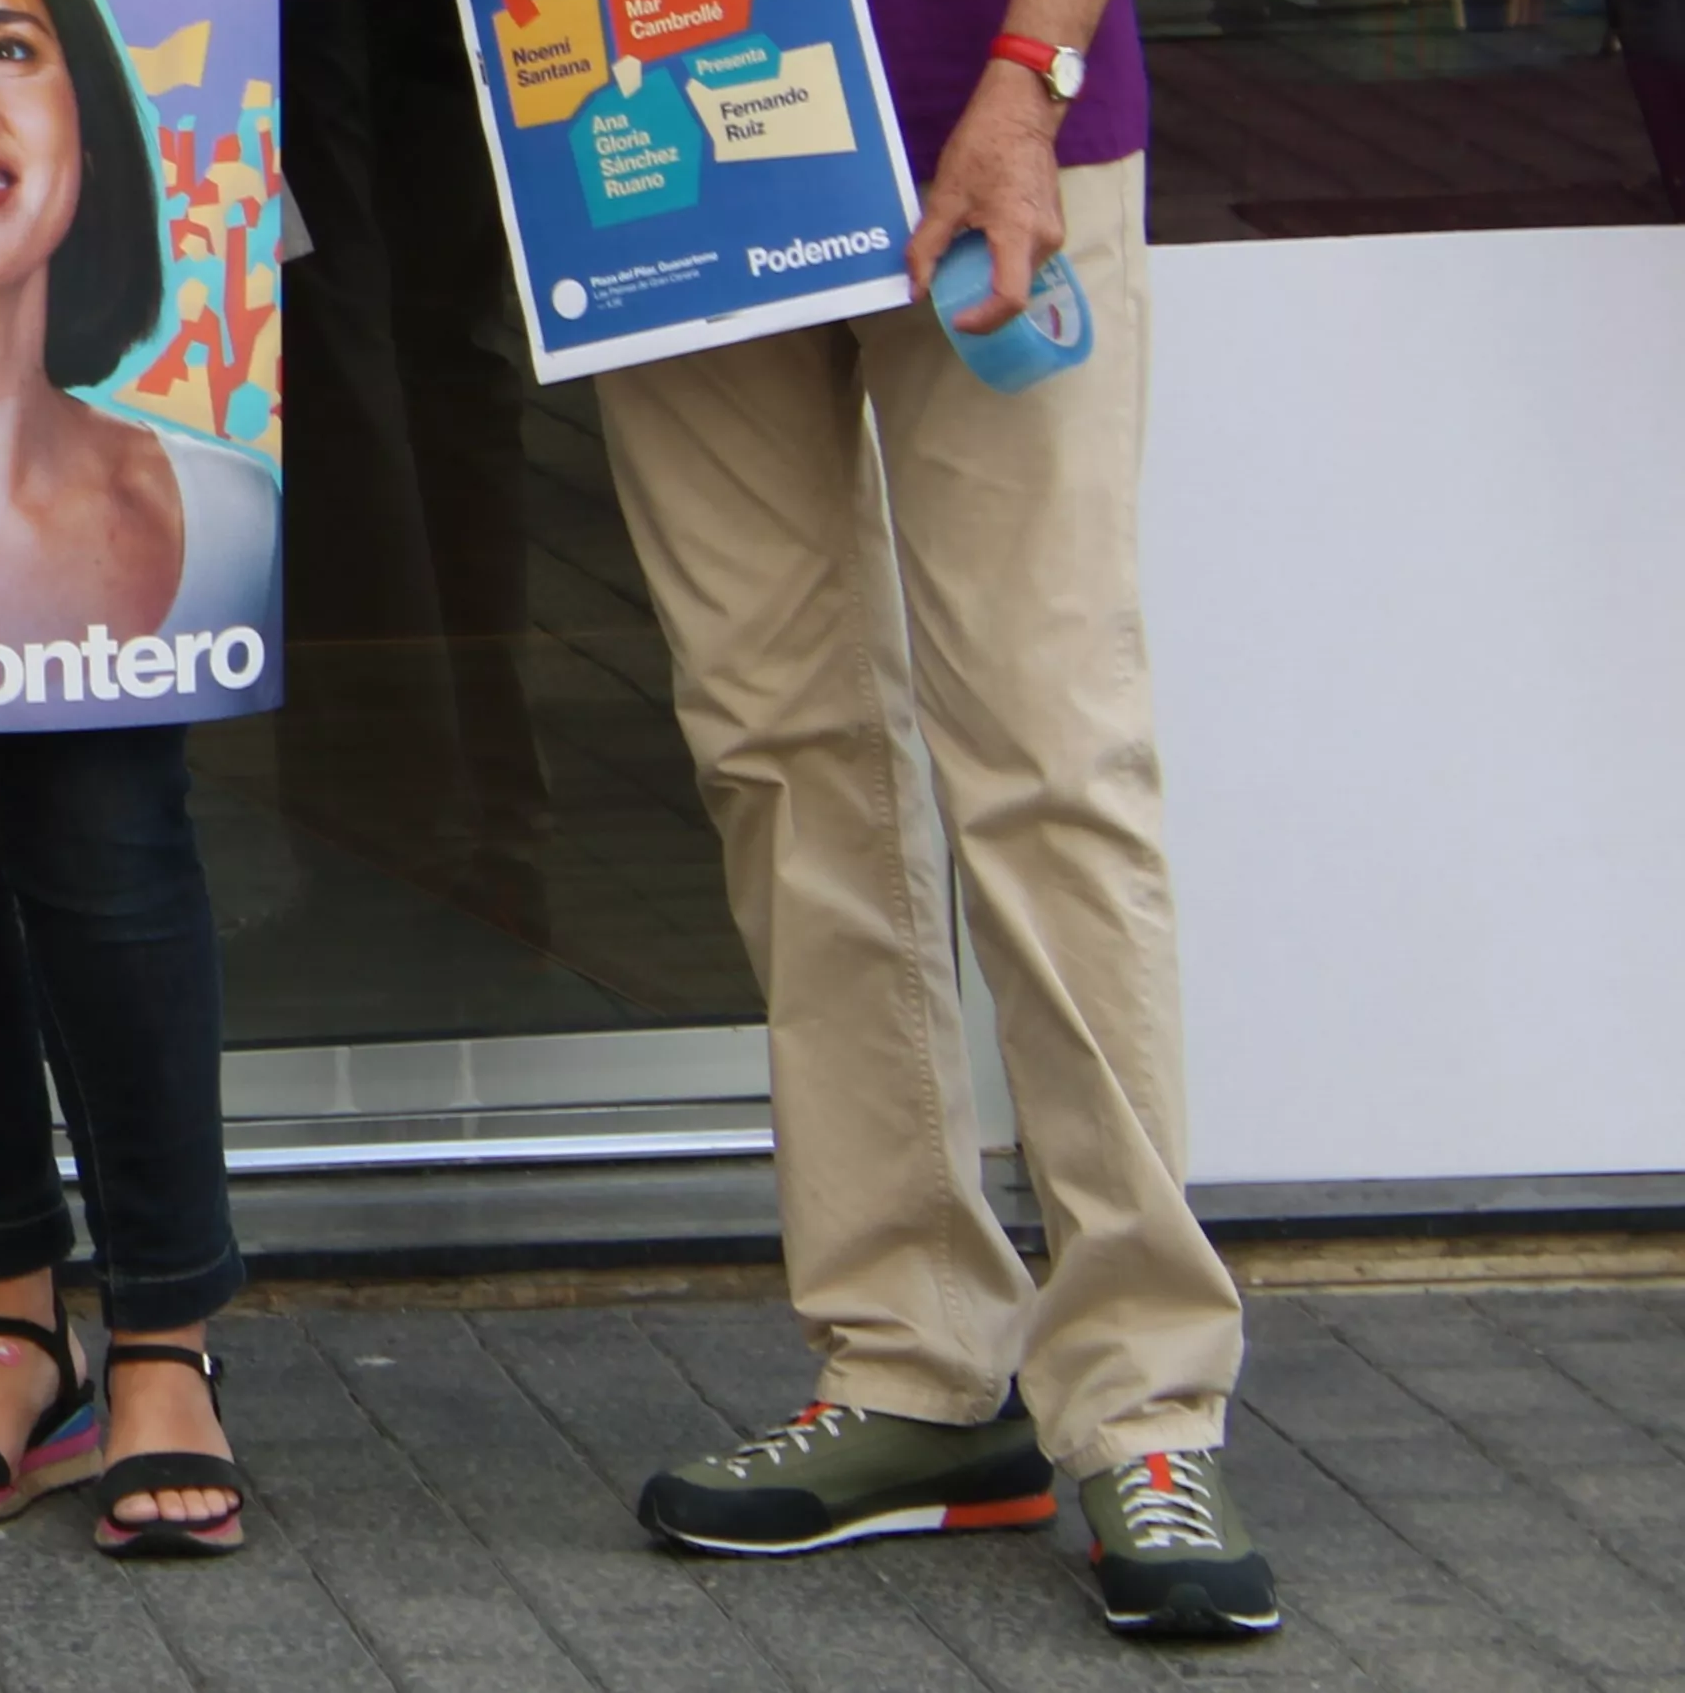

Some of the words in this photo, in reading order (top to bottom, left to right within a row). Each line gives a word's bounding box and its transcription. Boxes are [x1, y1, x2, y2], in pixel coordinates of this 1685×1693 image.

[630, 1, 723, 40] Cambrollé
[517, 59, 592, 88] Santana
[695, 48, 767, 76] Presenta
[720, 88, 809, 120] Fernando
[592, 114, 628, 135] Ana
[726, 119, 766, 143] Ruiz
[595, 131, 651, 156] Gloria
[599, 147, 679, 177] Sánchez
[604, 172, 665, 199] Ruano
[746, 225, 891, 277] Podemos
